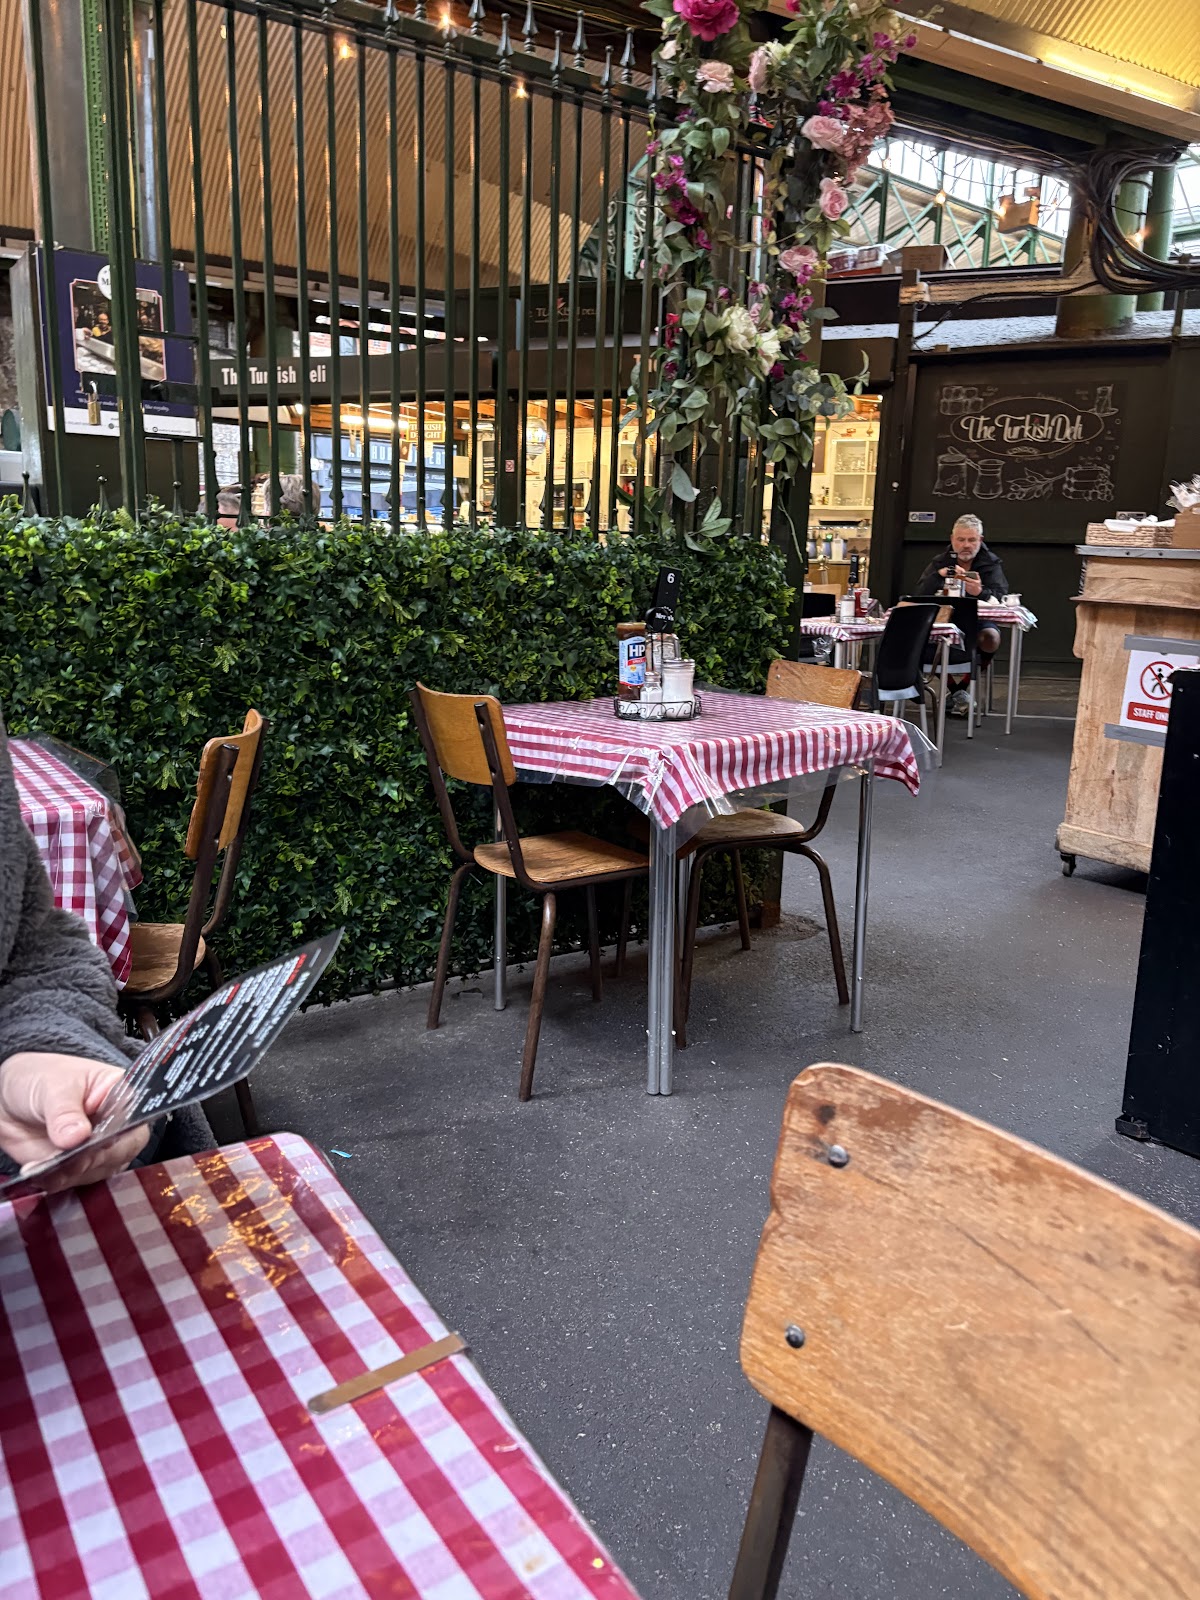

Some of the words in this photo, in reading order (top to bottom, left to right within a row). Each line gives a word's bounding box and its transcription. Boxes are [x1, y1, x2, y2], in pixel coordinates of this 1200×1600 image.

[221, 367, 238, 385] Th
[249, 365, 297, 384] Turish
[309, 364, 327, 383] eli
[960, 415, 996, 443] The
[994, 412, 1053, 443] Turkish
[1051, 413, 1084, 444] Deli
[667, 573, 675, 584] 6
[629, 645, 646, 657] HP
[1133, 707, 1155, 719] STAFF
